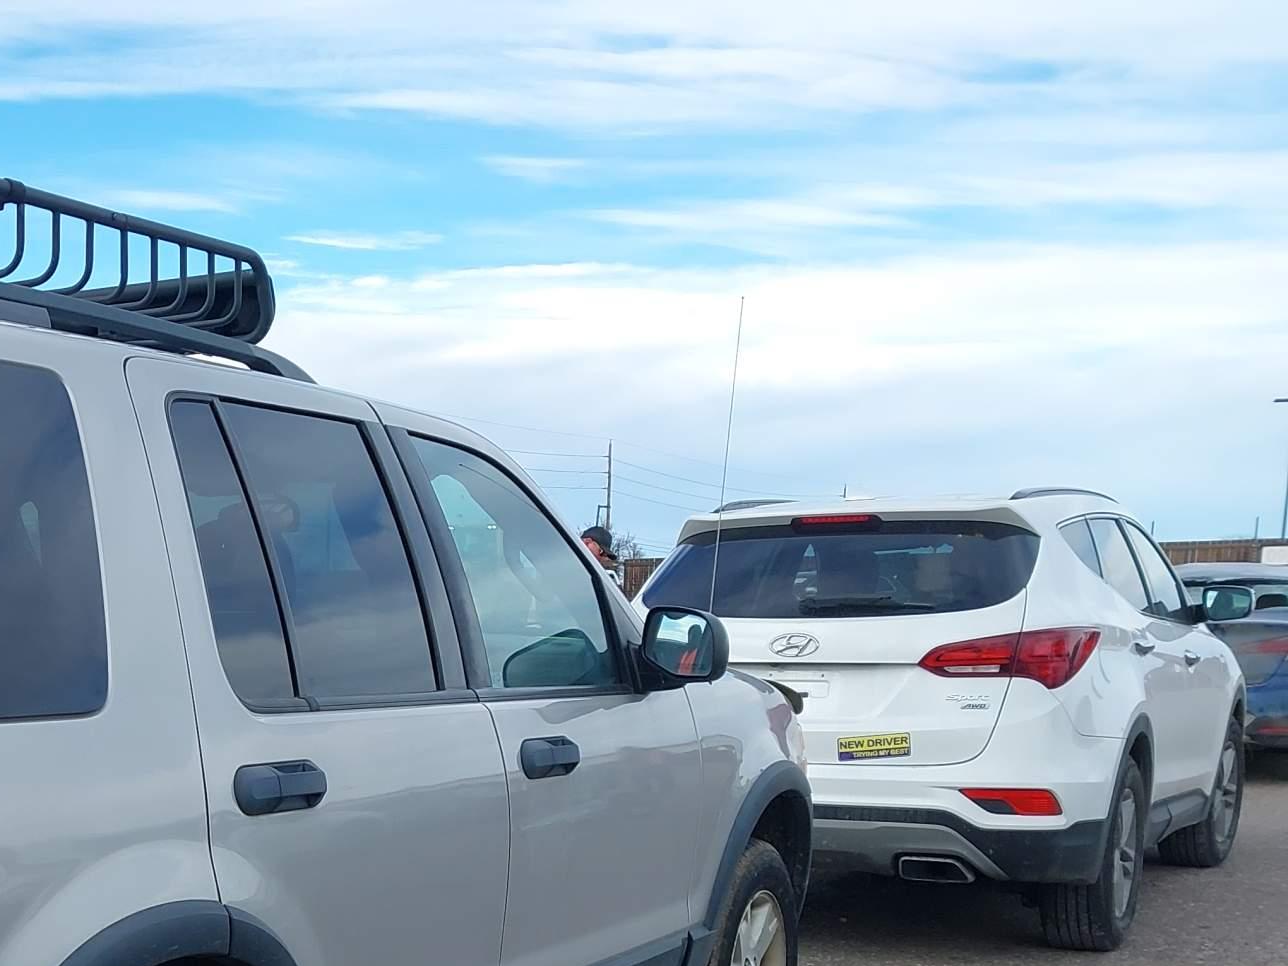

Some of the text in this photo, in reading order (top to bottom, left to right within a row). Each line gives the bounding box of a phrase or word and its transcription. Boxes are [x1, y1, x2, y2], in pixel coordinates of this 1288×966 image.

[839, 736, 909, 750] NEW DRIVER
[852, 750, 878, 758] TRYING
[890, 748, 909, 756] BEST
